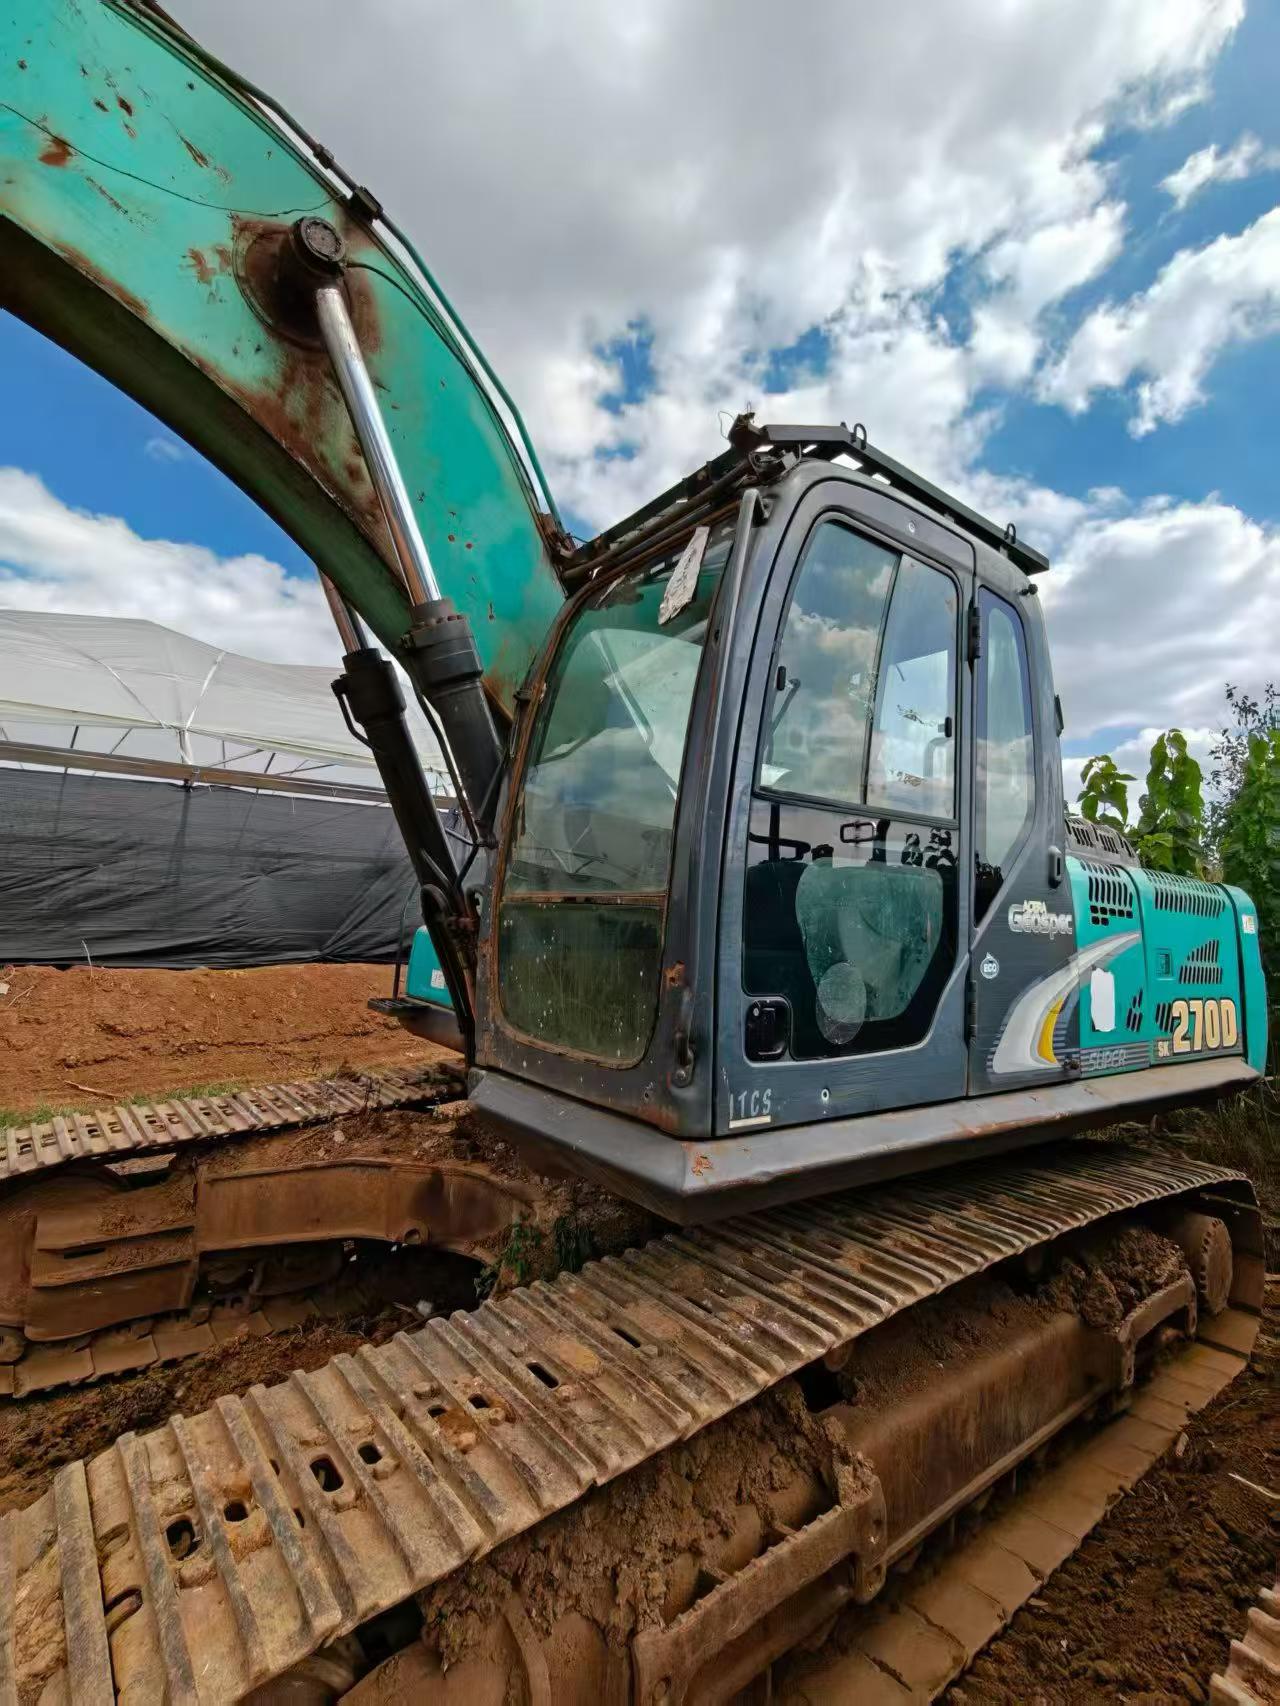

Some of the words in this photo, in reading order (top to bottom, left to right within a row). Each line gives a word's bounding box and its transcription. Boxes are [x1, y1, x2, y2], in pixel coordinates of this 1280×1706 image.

[1157, 1041, 1170, 1057] SK
[1171, 998, 1238, 1054] 270D
[1088, 1049, 1127, 1071] SUPER
[729, 1088, 772, 1120] ITCS
